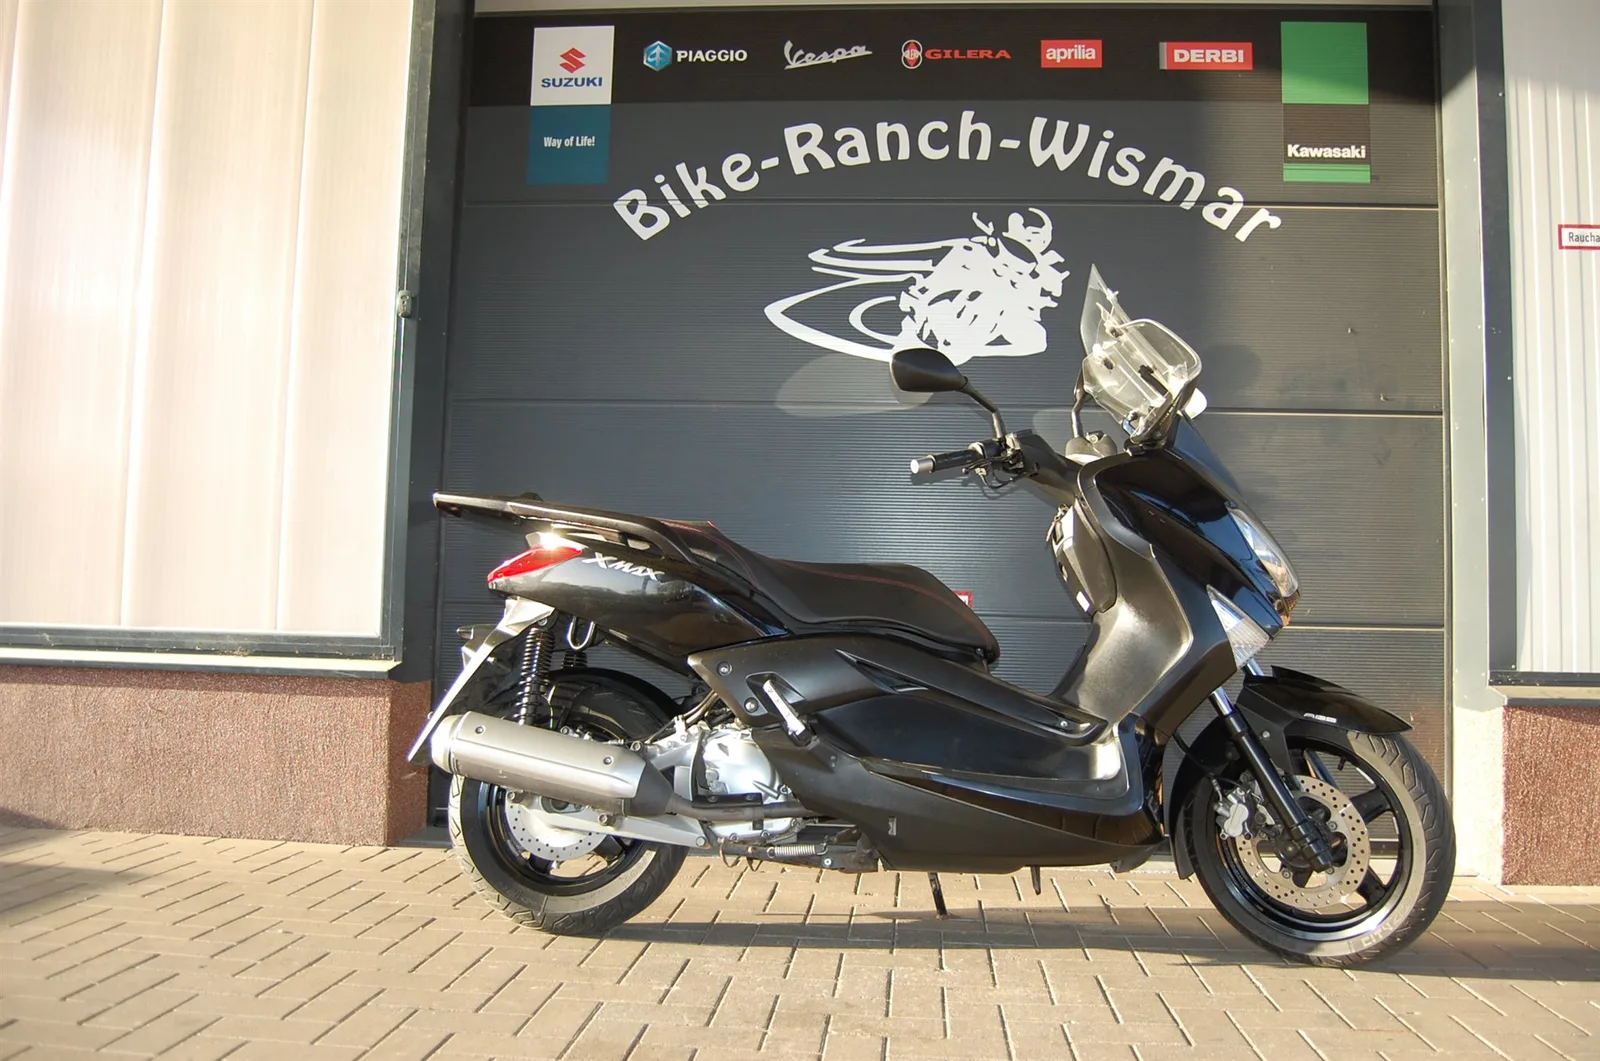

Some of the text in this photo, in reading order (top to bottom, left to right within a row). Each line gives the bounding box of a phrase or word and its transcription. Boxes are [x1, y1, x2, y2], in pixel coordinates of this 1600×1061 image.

[676, 49, 748, 62] PIAGGIO
[784, 40, 873, 70] Vespa
[924, 48, 1012, 60] GILERA
[1045, 44, 1096, 63] aprilia
[1173, 49, 1244, 63] DERBI
[541, 76, 603, 88] SUZUKI
[543, 135, 596, 149] Way of Life!
[1287, 144, 1366, 159] Kawasaki
[613, 110, 1282, 242] Bike-Ranch-Wismar
